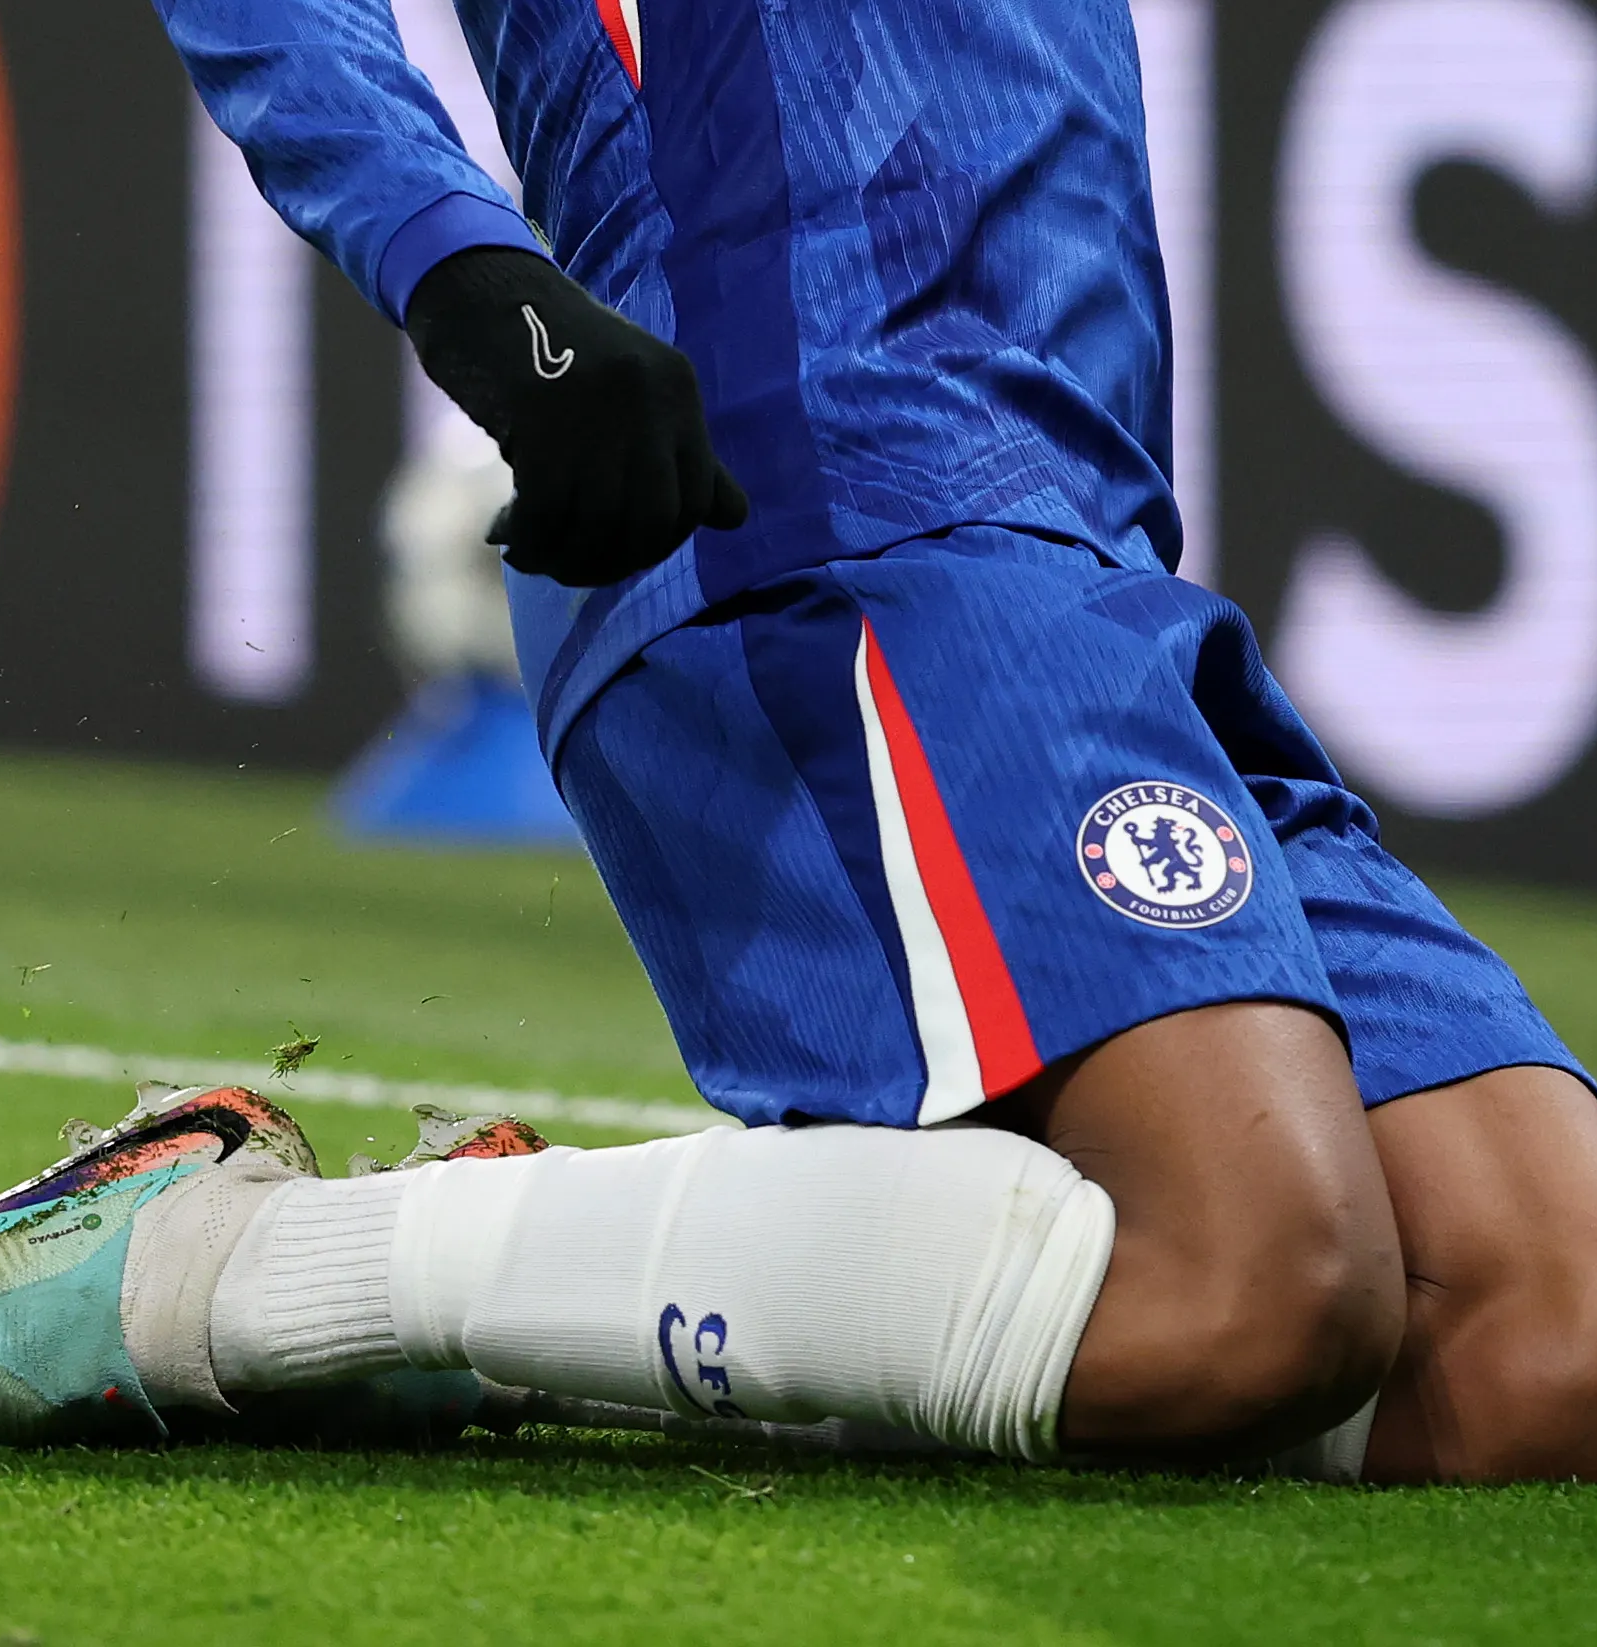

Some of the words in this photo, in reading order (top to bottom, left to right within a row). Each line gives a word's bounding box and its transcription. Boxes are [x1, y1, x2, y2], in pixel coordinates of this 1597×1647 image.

[1094, 787, 1200, 826] CHELSEA
[1129, 899, 1206, 920] FOOTBALL
[1210, 887, 1237, 912] CLUB
